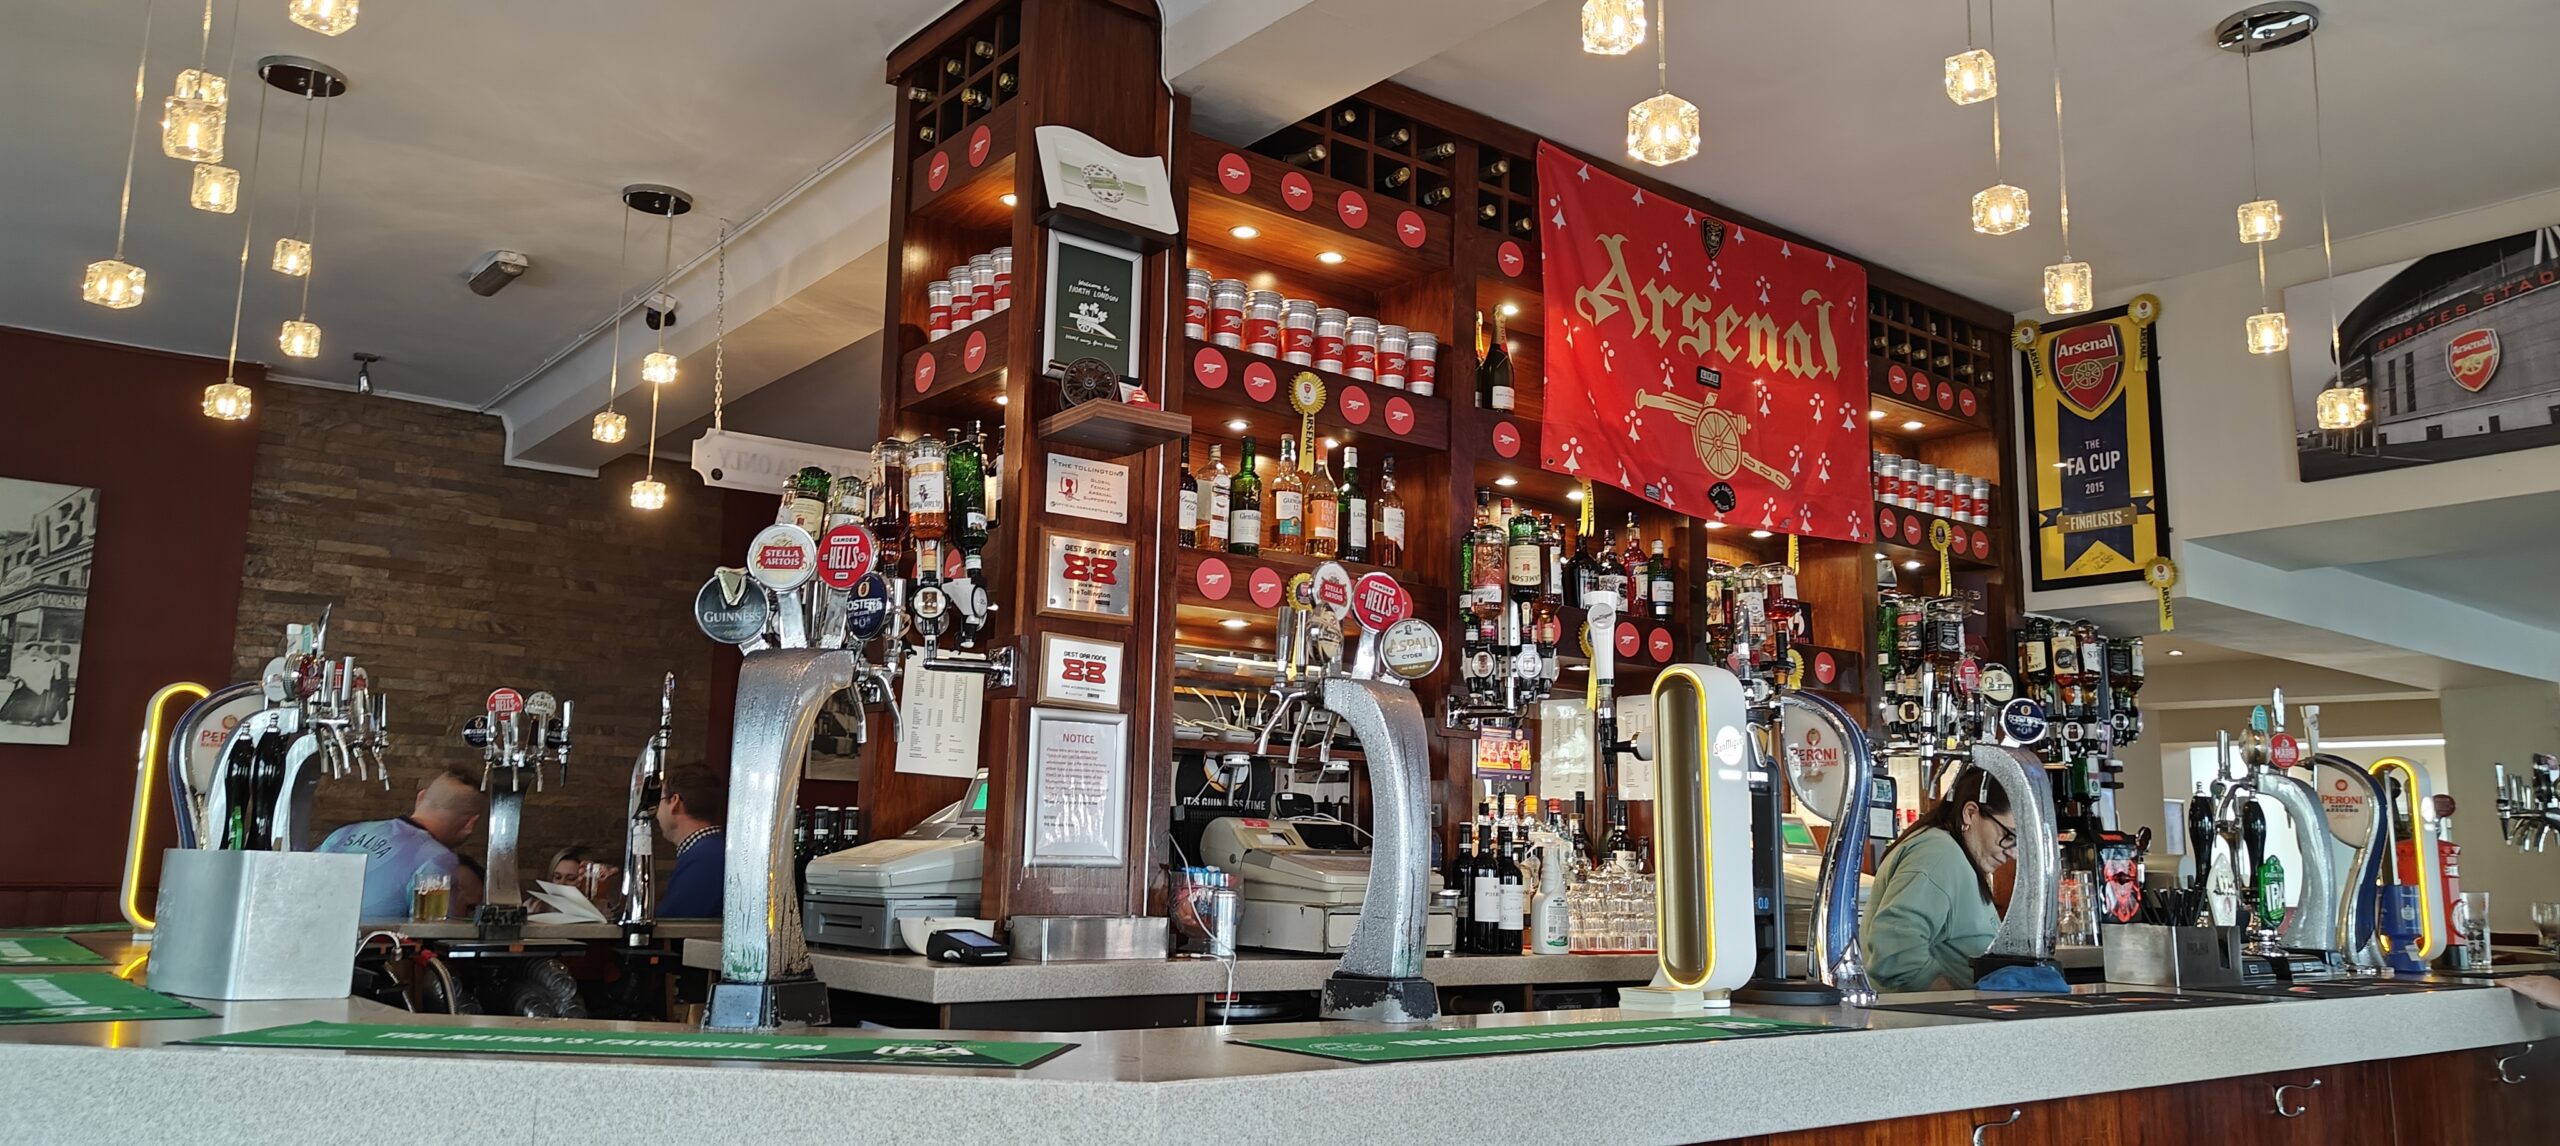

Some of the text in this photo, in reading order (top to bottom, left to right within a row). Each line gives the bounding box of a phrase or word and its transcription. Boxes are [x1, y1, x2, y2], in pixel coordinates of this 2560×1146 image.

[1069, 285, 1119, 302] NORTH LONDON
[1575, 233, 1841, 382] Arsenal
[2377, 303, 2468, 350] EMIRATES
[2058, 334, 2113, 358] Arsenal
[2140, 327, 2148, 359] ARSENAL
[2452, 336, 2489, 353] Arsenal
[2029, 348, 2043, 378] ARSENAL
[1305, 411, 1314, 455] ARSENAL
[2085, 439, 2101, 450] THE
[1058, 461, 1119, 477] THE TOLLINGTON
[2067, 450, 2121, 476] FA CUP
[2085, 481, 2105, 494] 2015
[2070, 510, 2122, 531] FINALISTS
[765, 549, 799, 557] STELLA
[828, 545, 860, 569] HELLS
[765, 557, 800, 566] ARTOIS
[1324, 583, 1343, 594] STELLA
[1371, 582, 1395, 595] CAMDEN
[1365, 589, 1395, 617] HELLS
[2162, 587, 2173, 620] ARSENAL
[703, 610, 762, 622] GUINNESS
[1387, 636, 1437, 657] ASPALL
[495, 699, 515, 712] HELLS
[1062, 733, 1096, 745] NOTICE
[1791, 747, 1838, 761] PERONI
[2321, 795, 2363, 805] PERONI
[593, 1038, 771, 1049] FAVOURITE
[873, 1045, 975, 1056] IPA
